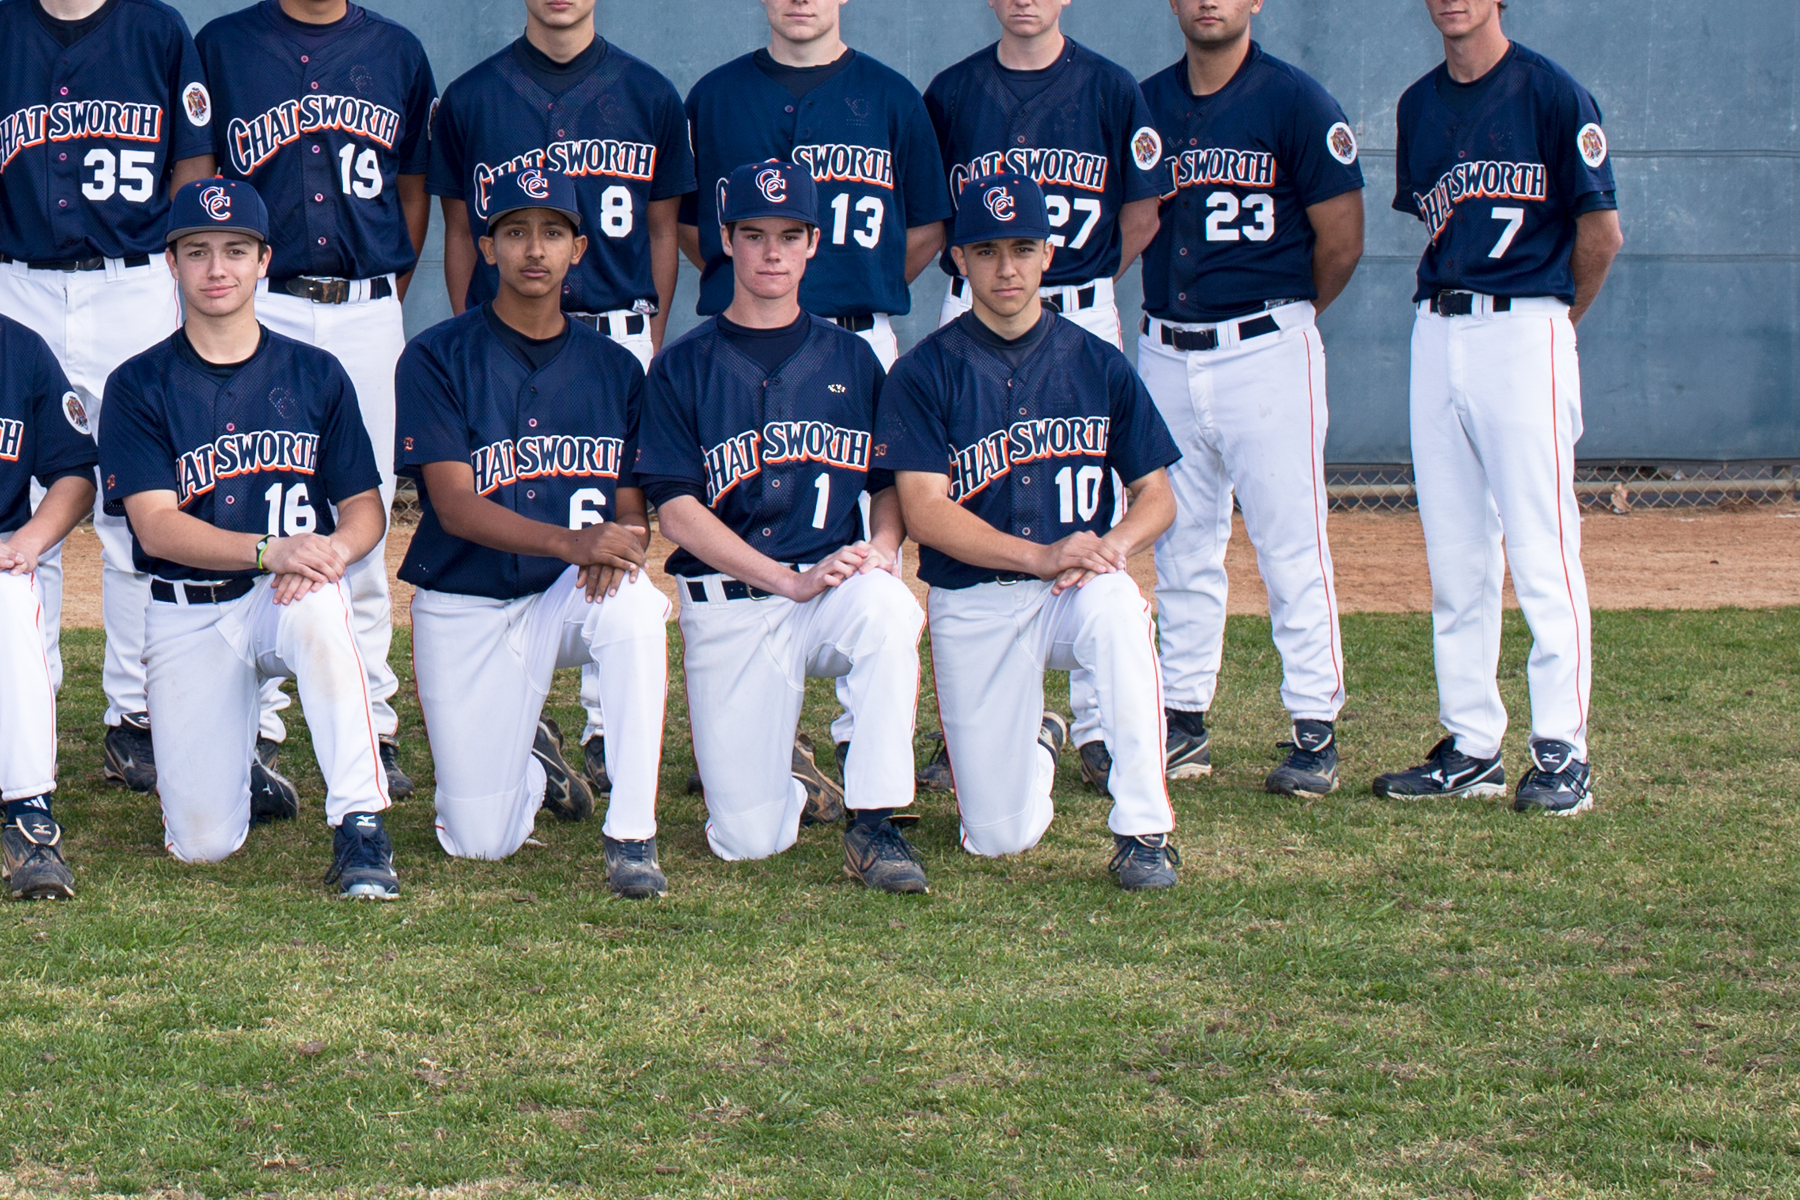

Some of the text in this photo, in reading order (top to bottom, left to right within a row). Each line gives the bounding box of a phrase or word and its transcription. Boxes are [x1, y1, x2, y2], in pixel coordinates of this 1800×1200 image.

[227, 94, 400, 176] CHATSWORTH
[81, 147, 155, 203] 35
[338, 142, 384, 199] 19
[600, 185, 634, 238] 8
[830, 193, 884, 249] 13
[1044, 194, 1102, 250] 27
[1205, 191, 1276, 241] 23
[1487, 206, 1525, 259] 7
[264, 482, 317, 538] 16
[569, 487, 607, 530] 6
[812, 472, 831, 529] 1
[1055, 465, 1103, 523] 10
